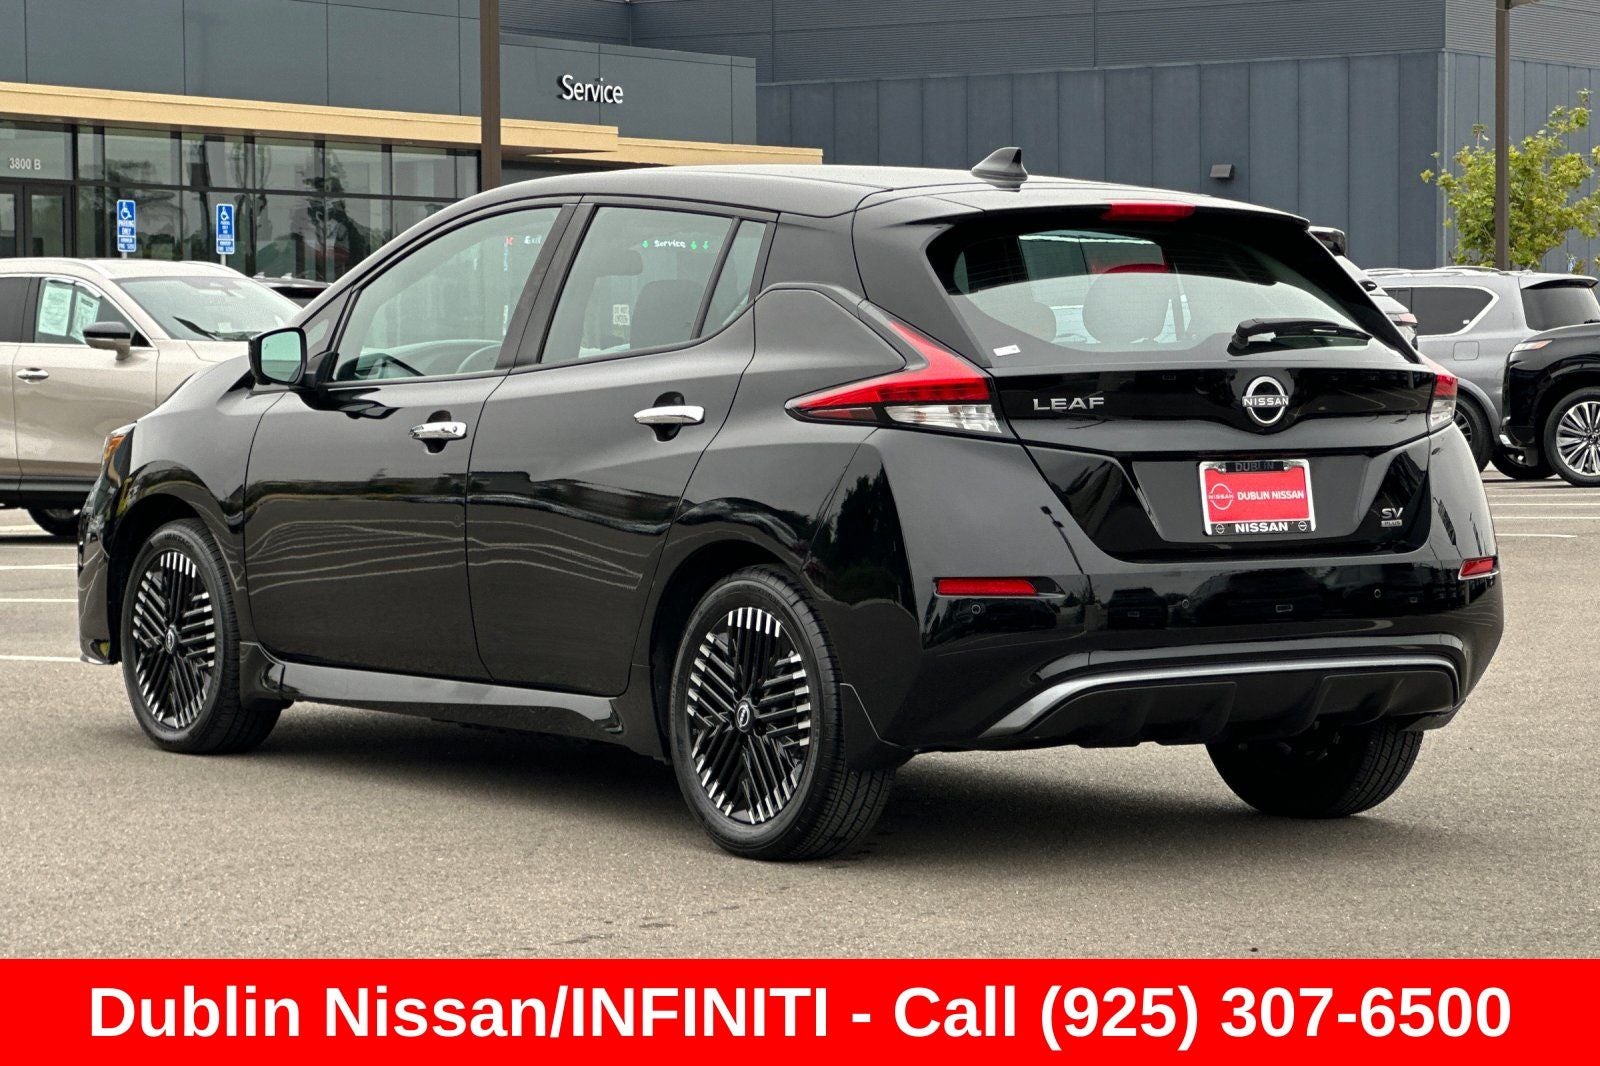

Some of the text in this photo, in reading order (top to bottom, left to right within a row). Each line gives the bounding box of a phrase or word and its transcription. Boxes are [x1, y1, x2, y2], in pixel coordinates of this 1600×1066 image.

[561, 74, 623, 104] Service
[9, 157, 41, 170] 3800 B
[654, 239, 686, 248] Service
[1033, 397, 1105, 411] LEAF
[1243, 396, 1289, 407] NISSAN
[1235, 462, 1274, 472] DUBLIN
[1237, 490, 1305, 500] DUBLIN NISSAN
[1381, 507, 1403, 518] SV
[1235, 522, 1288, 533] NISSAN
